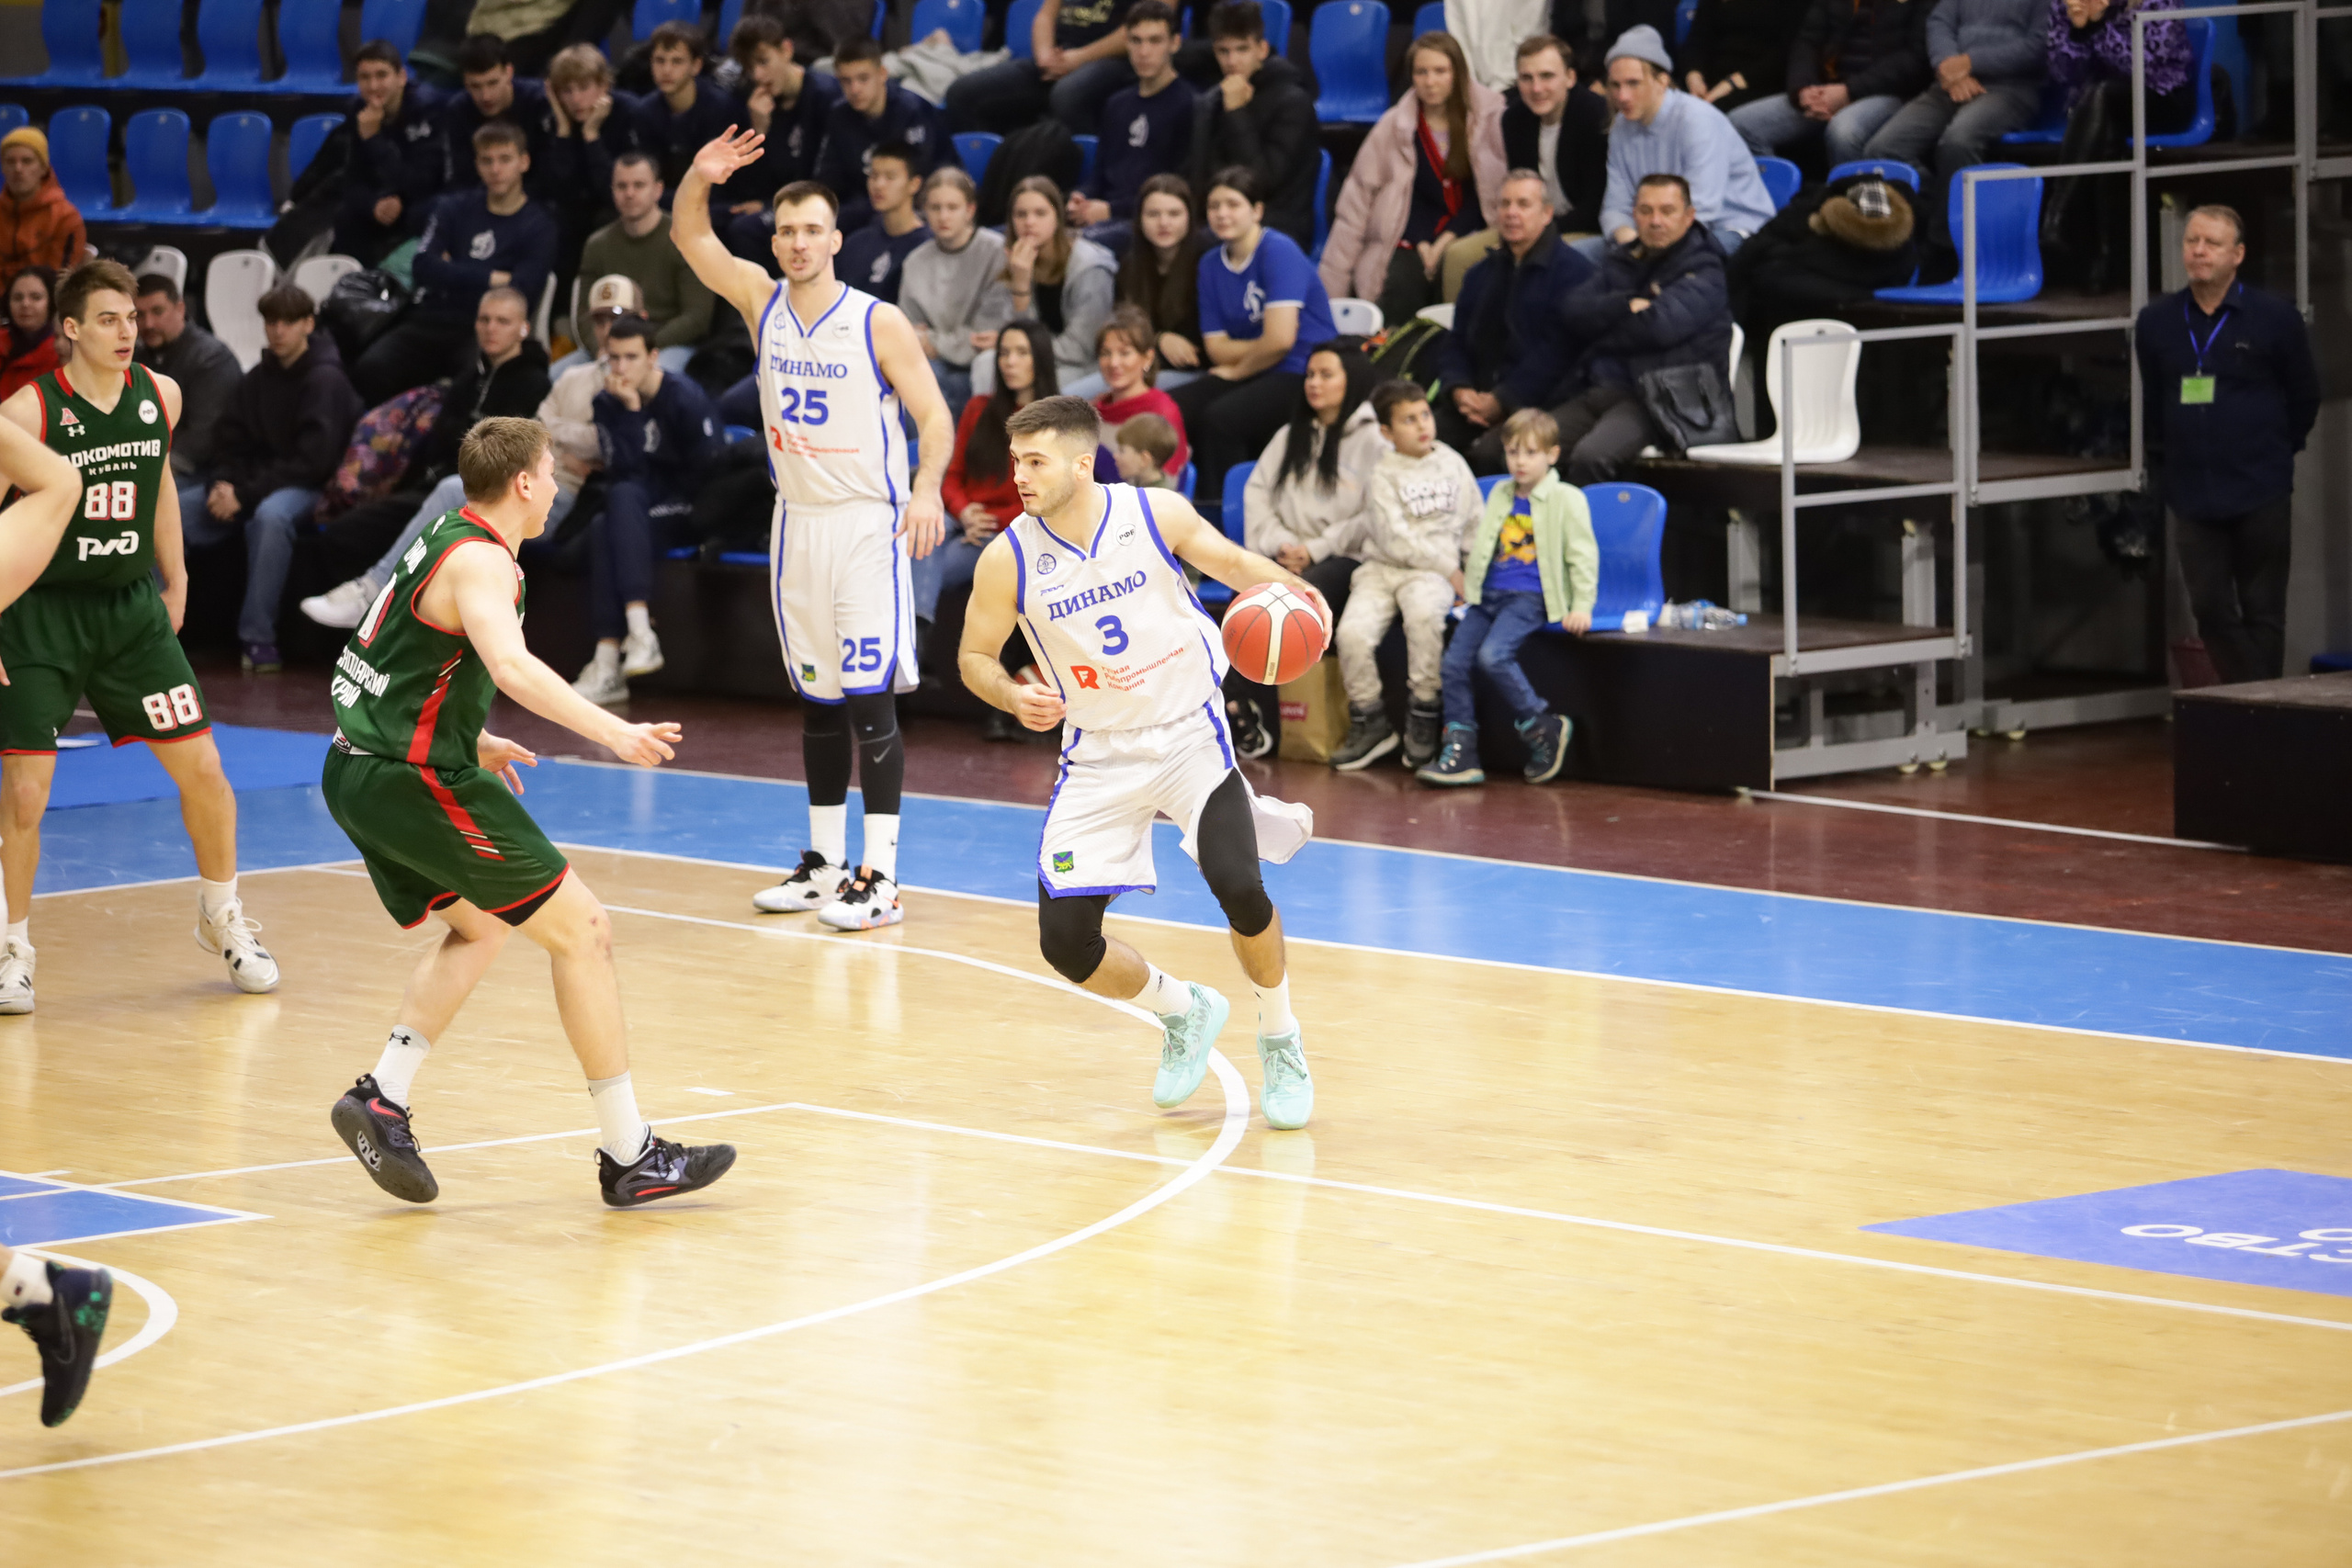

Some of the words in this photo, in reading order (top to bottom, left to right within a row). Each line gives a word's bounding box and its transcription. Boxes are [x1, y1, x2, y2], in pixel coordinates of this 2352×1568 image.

[781, 387, 829, 425] 25
[85, 480, 137, 521] 88
[1047, 570, 1147, 621] ДИНАМО
[842, 637, 882, 672] 25
[1095, 615, 1129, 656] 3
[141, 683, 203, 732] 88
